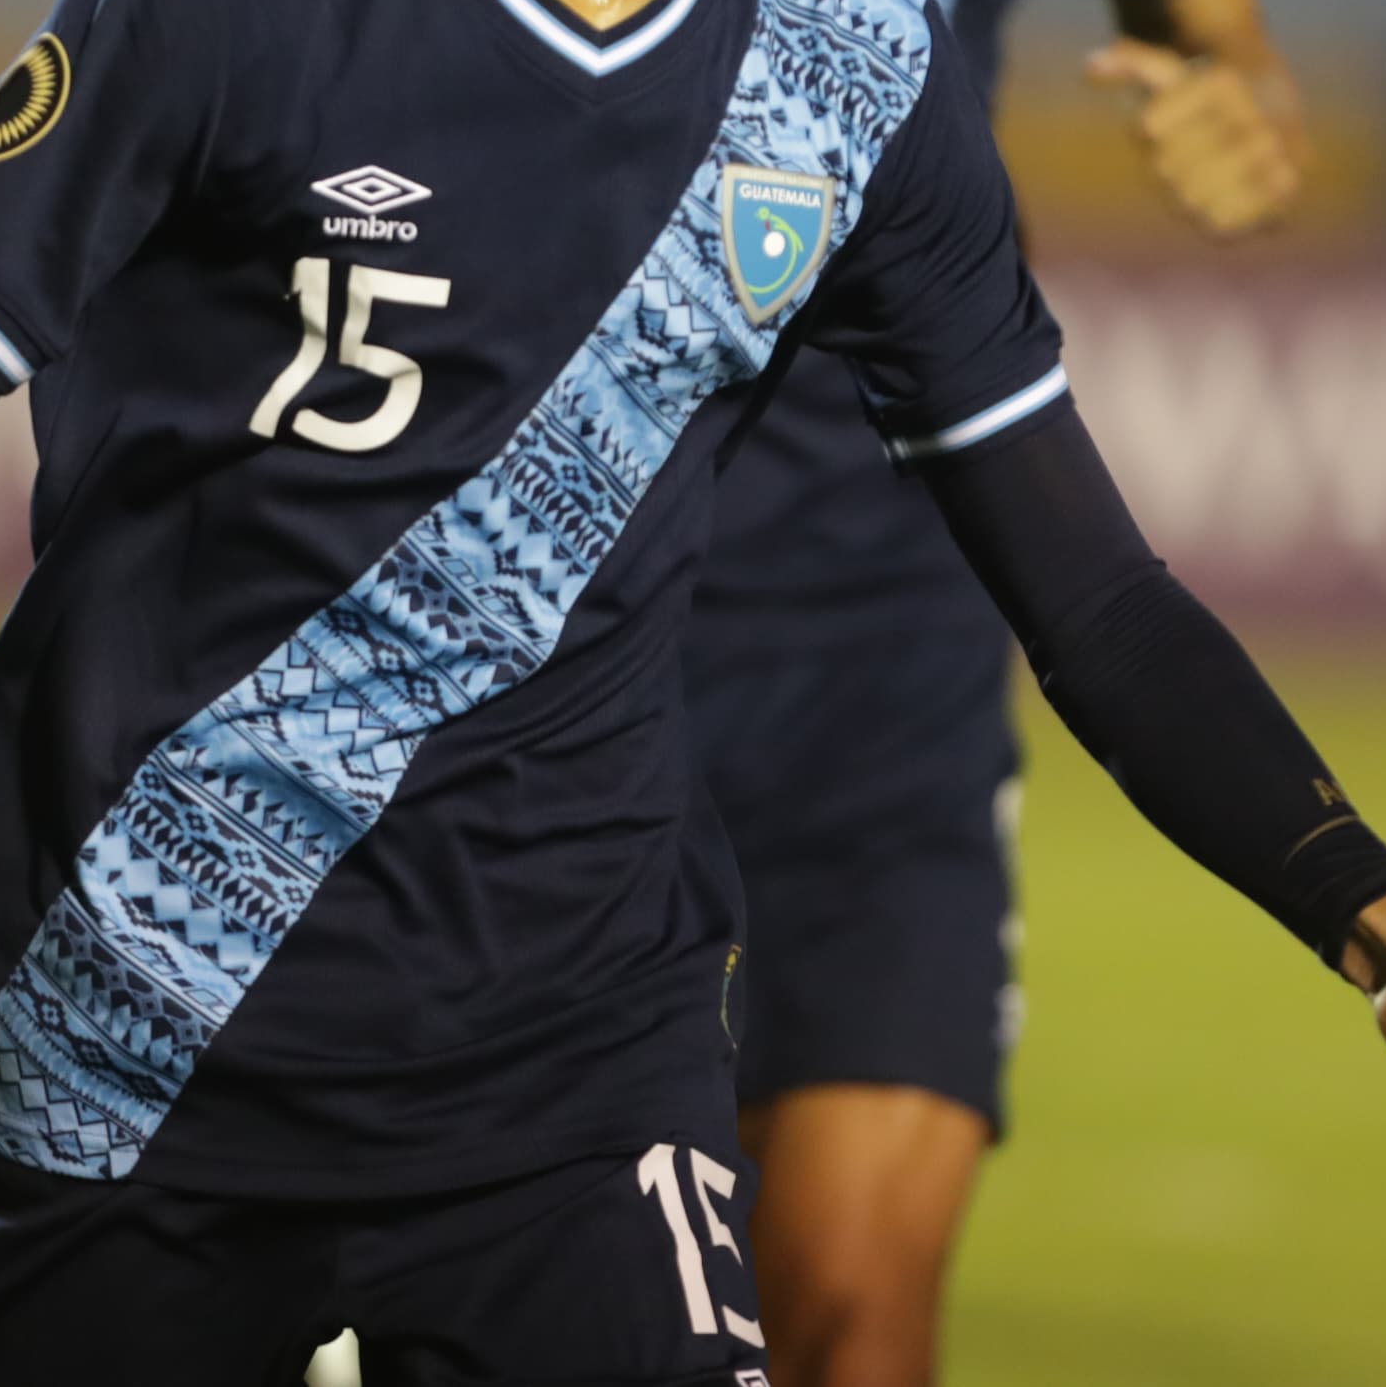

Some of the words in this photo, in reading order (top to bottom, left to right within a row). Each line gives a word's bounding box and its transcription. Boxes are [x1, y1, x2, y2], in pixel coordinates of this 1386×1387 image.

[324, 215, 419, 242] umbro
[740, 184, 822, 207] GUATEMALA
[249, 256, 452, 453] 15
[637, 1143, 766, 1349] 15
